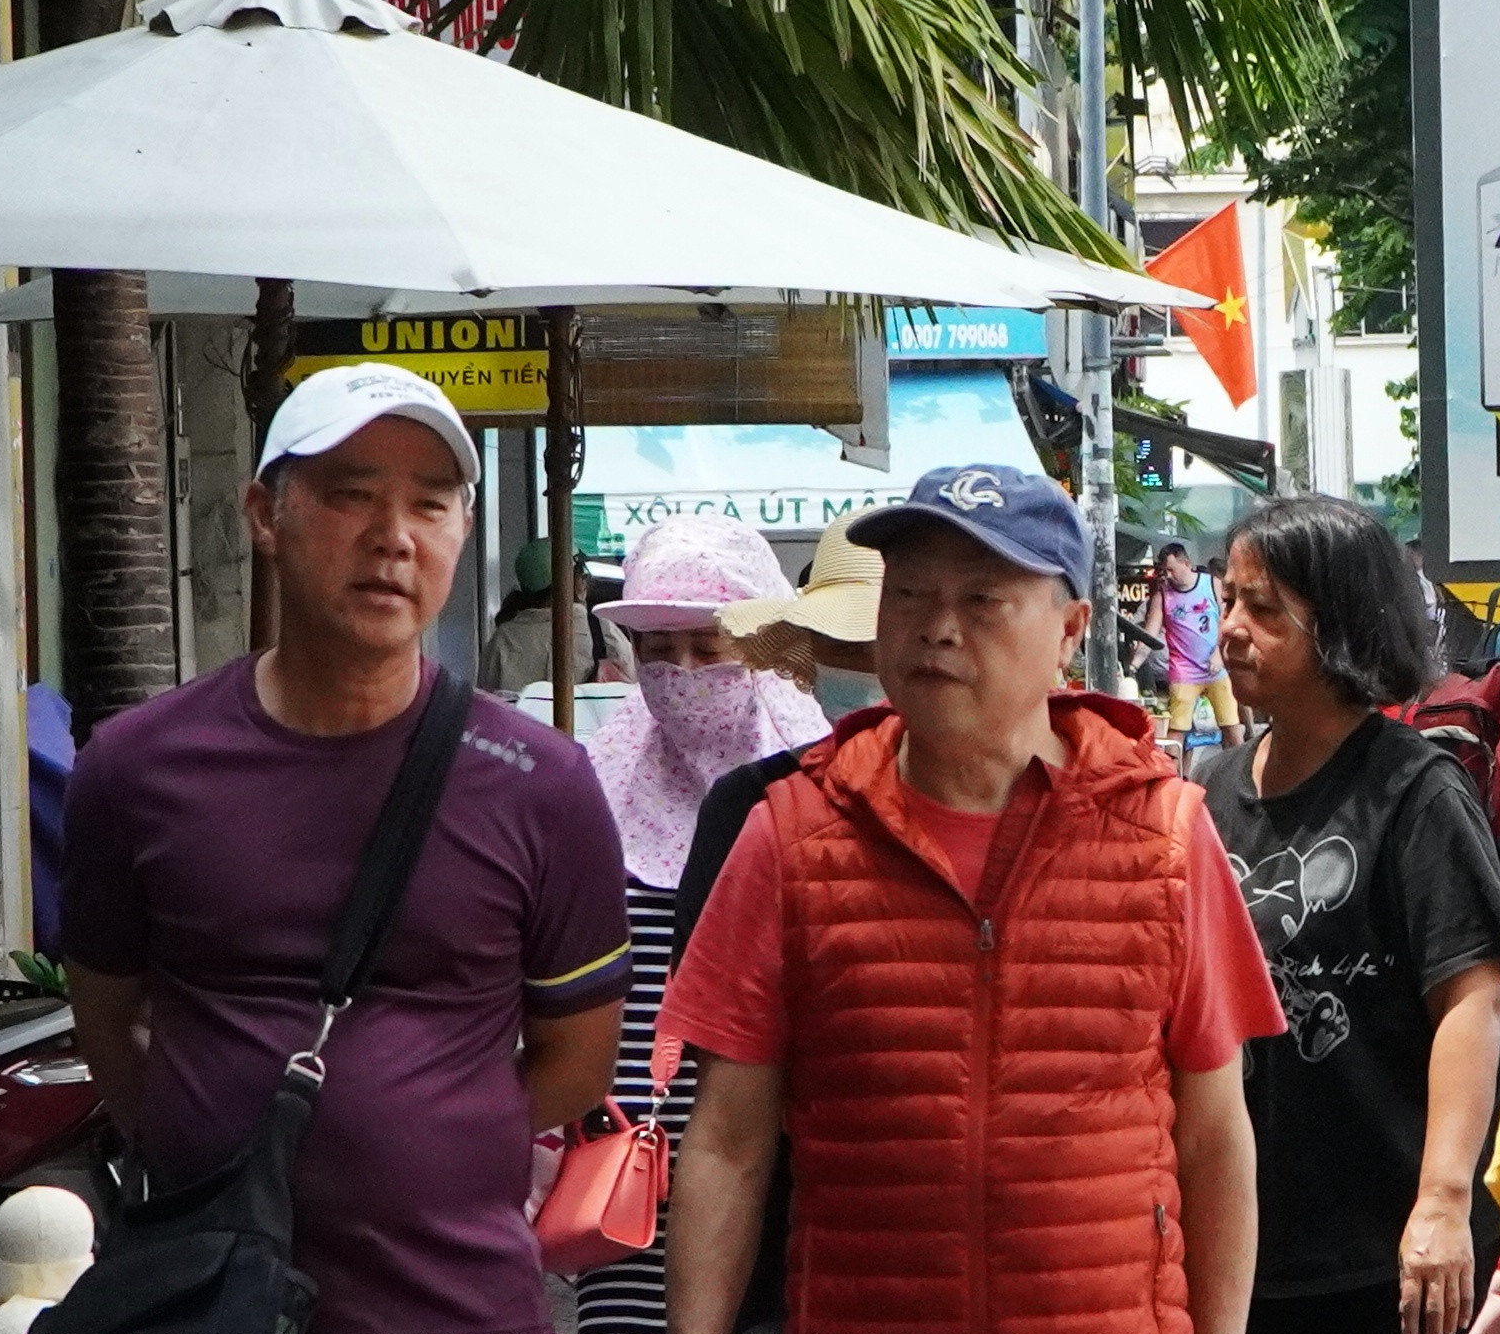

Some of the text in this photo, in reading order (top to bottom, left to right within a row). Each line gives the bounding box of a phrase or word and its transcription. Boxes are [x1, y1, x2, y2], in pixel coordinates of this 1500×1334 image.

[361, 319, 515, 351] UNION
[947, 322, 1008, 348] 799068
[422, 362, 492, 386] HUYỂN
[759, 491, 810, 524] ÚT
